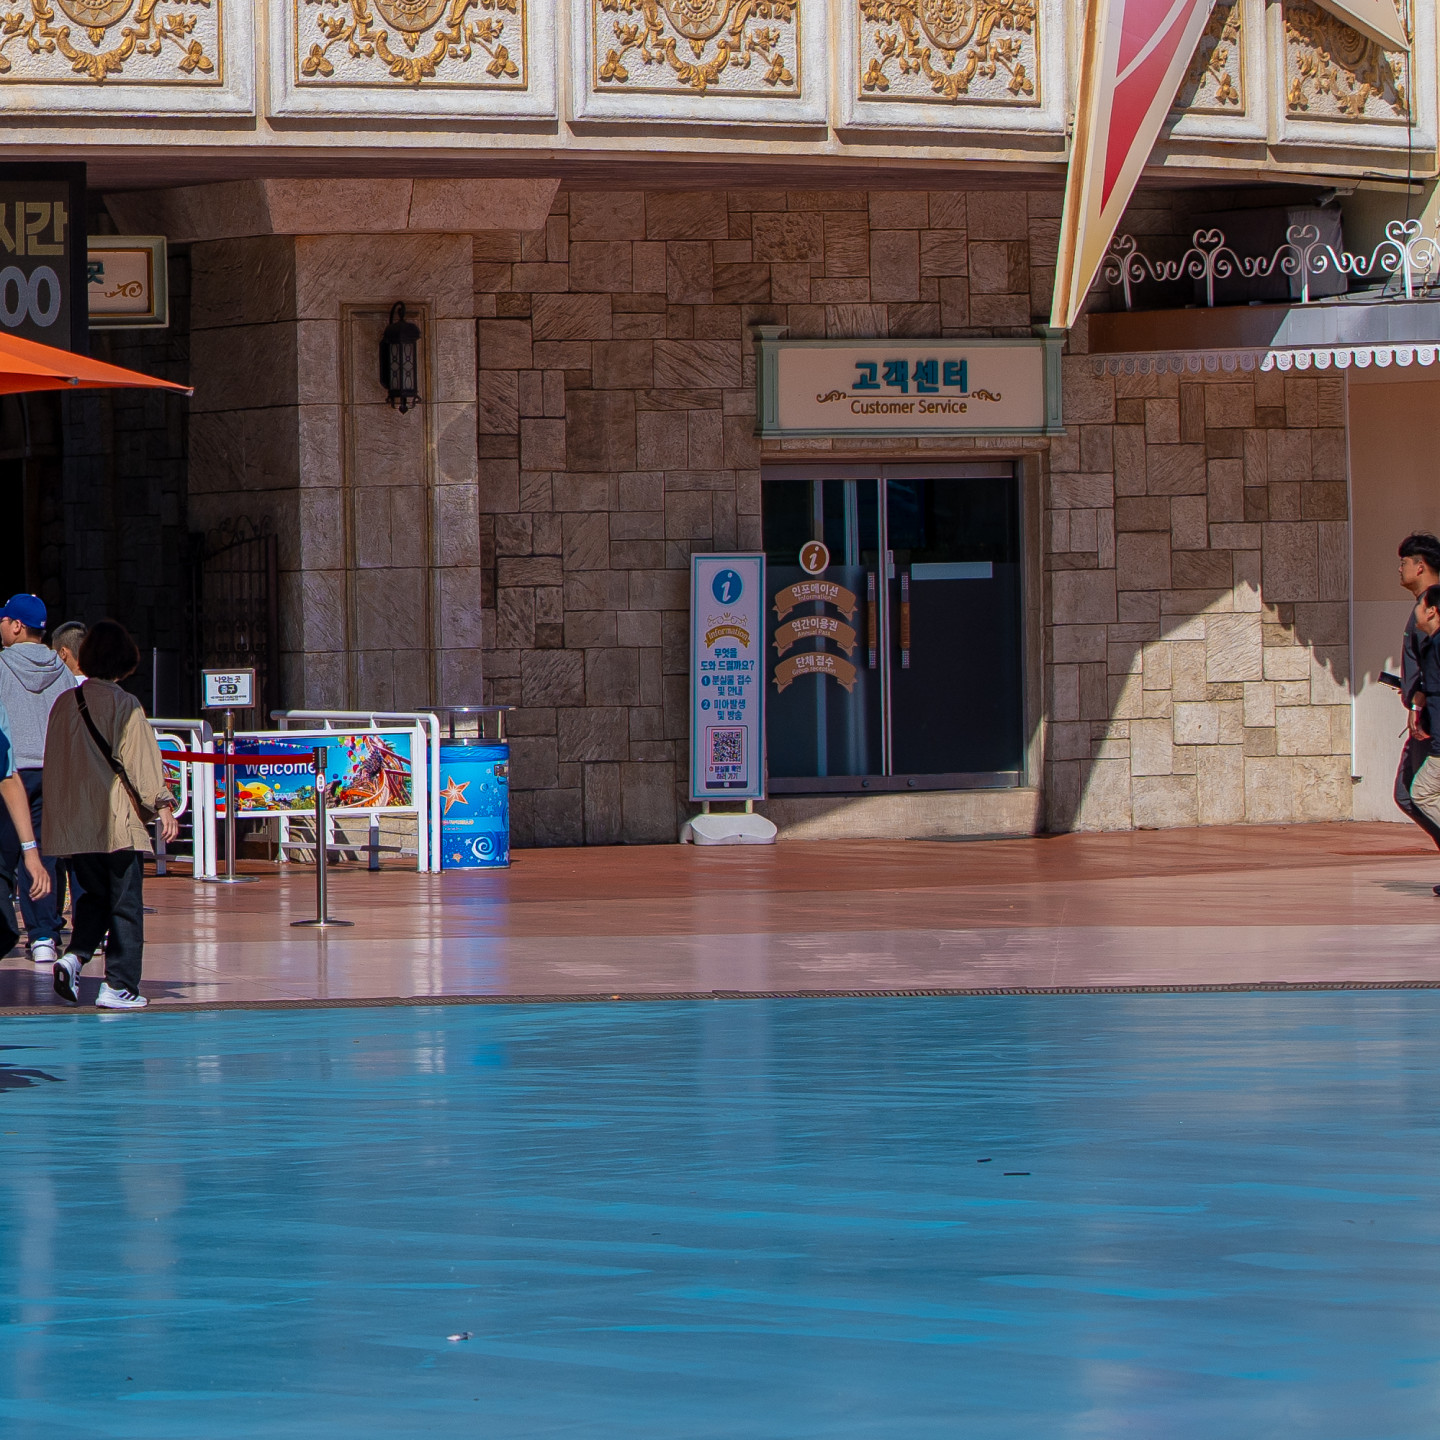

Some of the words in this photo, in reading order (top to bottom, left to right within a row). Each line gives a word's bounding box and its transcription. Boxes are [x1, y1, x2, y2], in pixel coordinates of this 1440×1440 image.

[851, 358, 968, 394] 고객센터
[850, 400, 915, 415] Customer
[918, 400, 968, 414] Service
[791, 618, 838, 632] 연간이용권
[714, 647, 738, 659] 무엇을
[700, 660, 717, 672] 도와
[718, 660, 755, 672] 드릴까요?
[795, 655, 814, 669] 단체
[815, 654, 834, 668] 접수
[712, 675, 735, 686] 분실물
[736, 675, 752, 686] 접수
[727, 686, 743, 697] 안내
[713, 699, 746, 709] 미아발생
[727, 710, 743, 721] 방송
